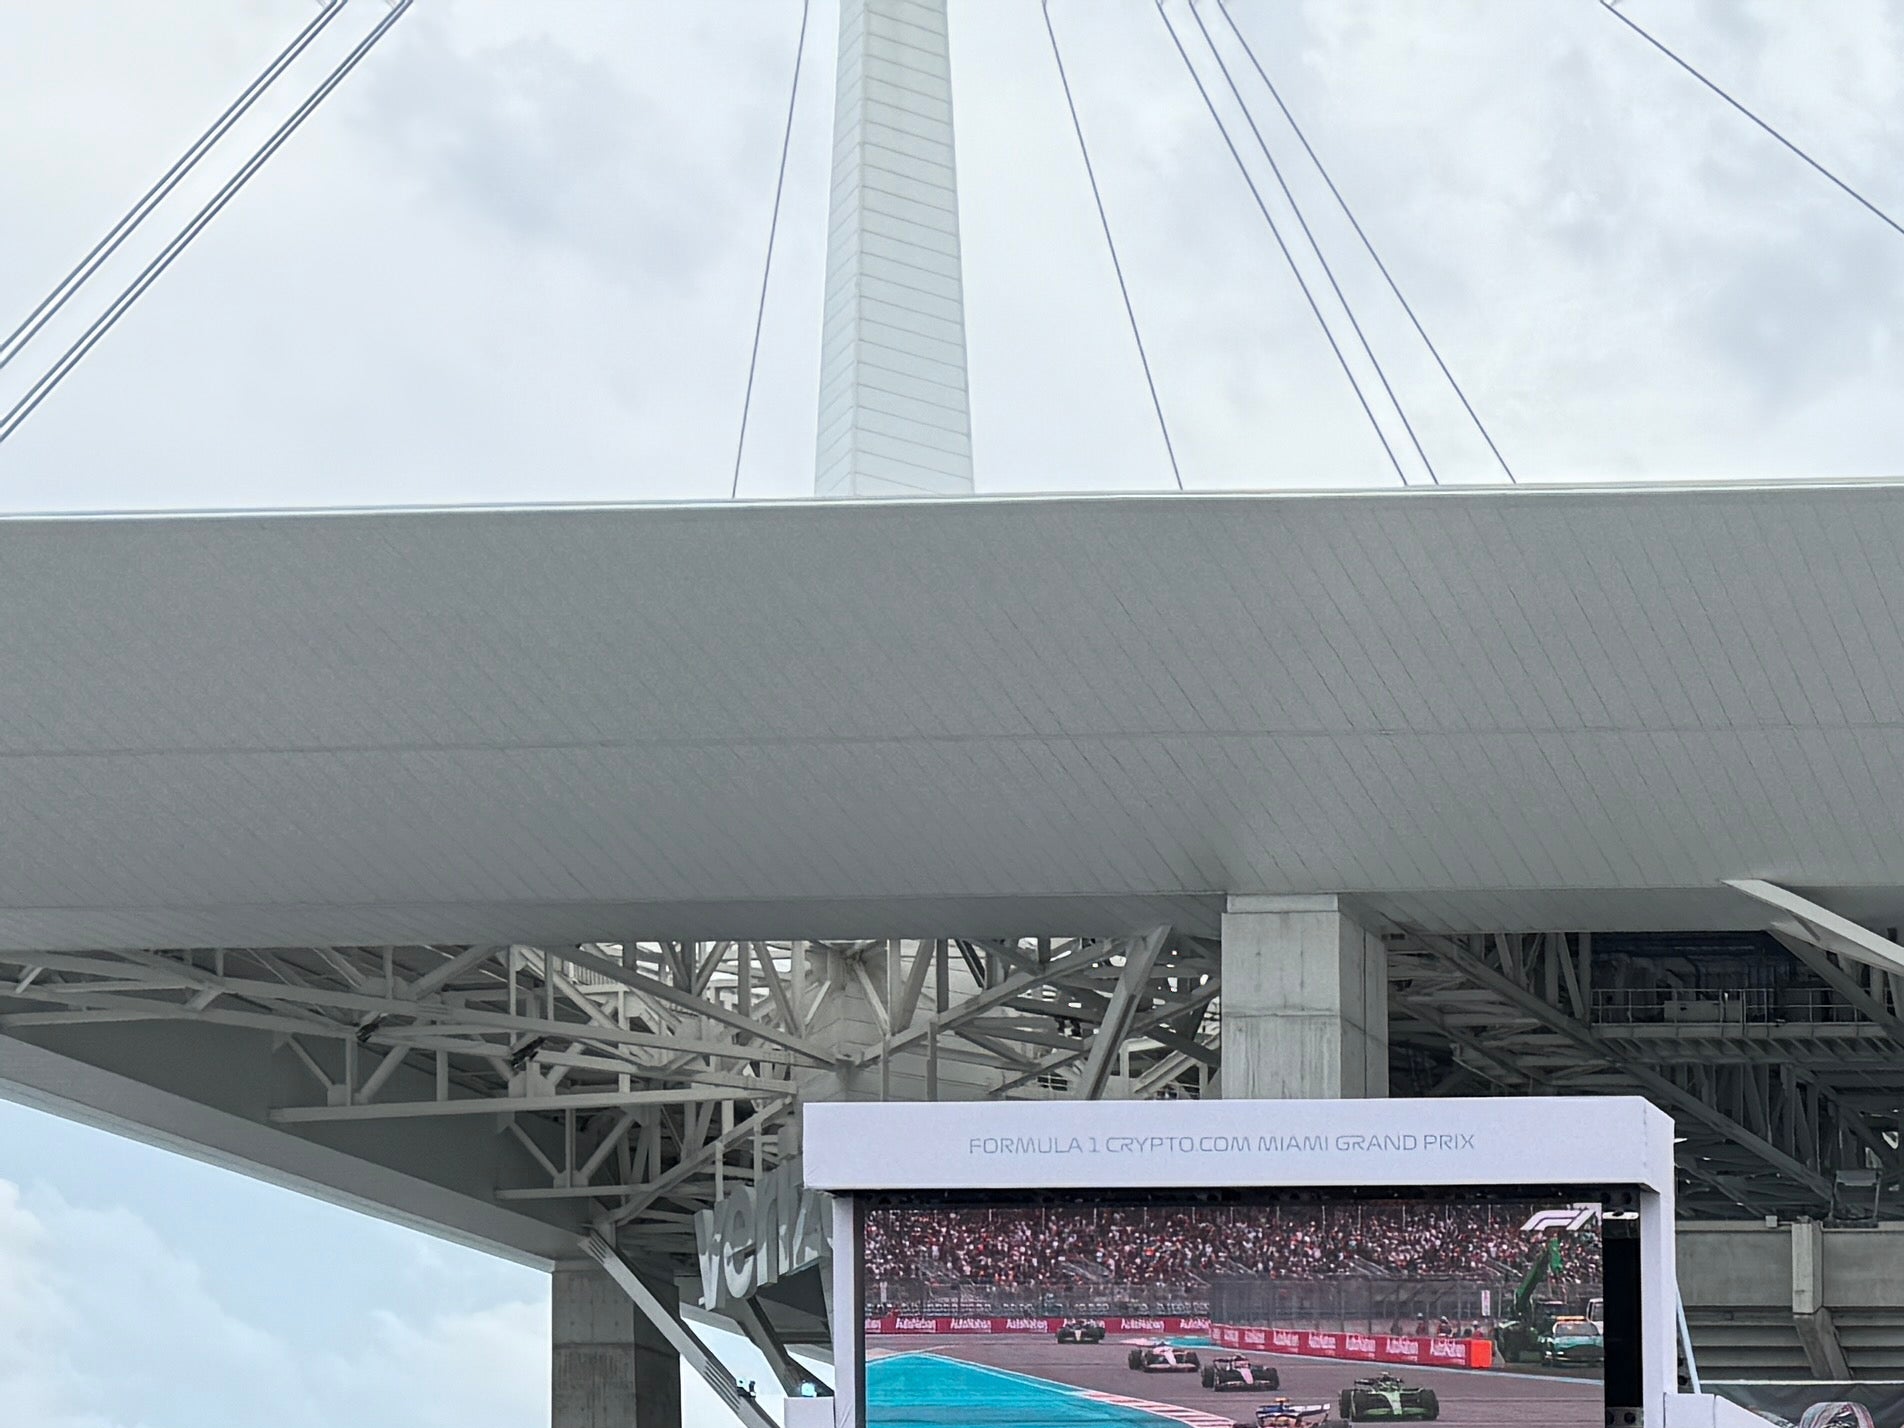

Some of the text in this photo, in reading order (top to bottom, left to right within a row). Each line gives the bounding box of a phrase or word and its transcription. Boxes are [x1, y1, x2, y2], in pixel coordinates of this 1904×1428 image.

[969, 1133, 1475, 1153] FORMULA 1 CRYPTO.COM MIAMI GRAND PRIX
